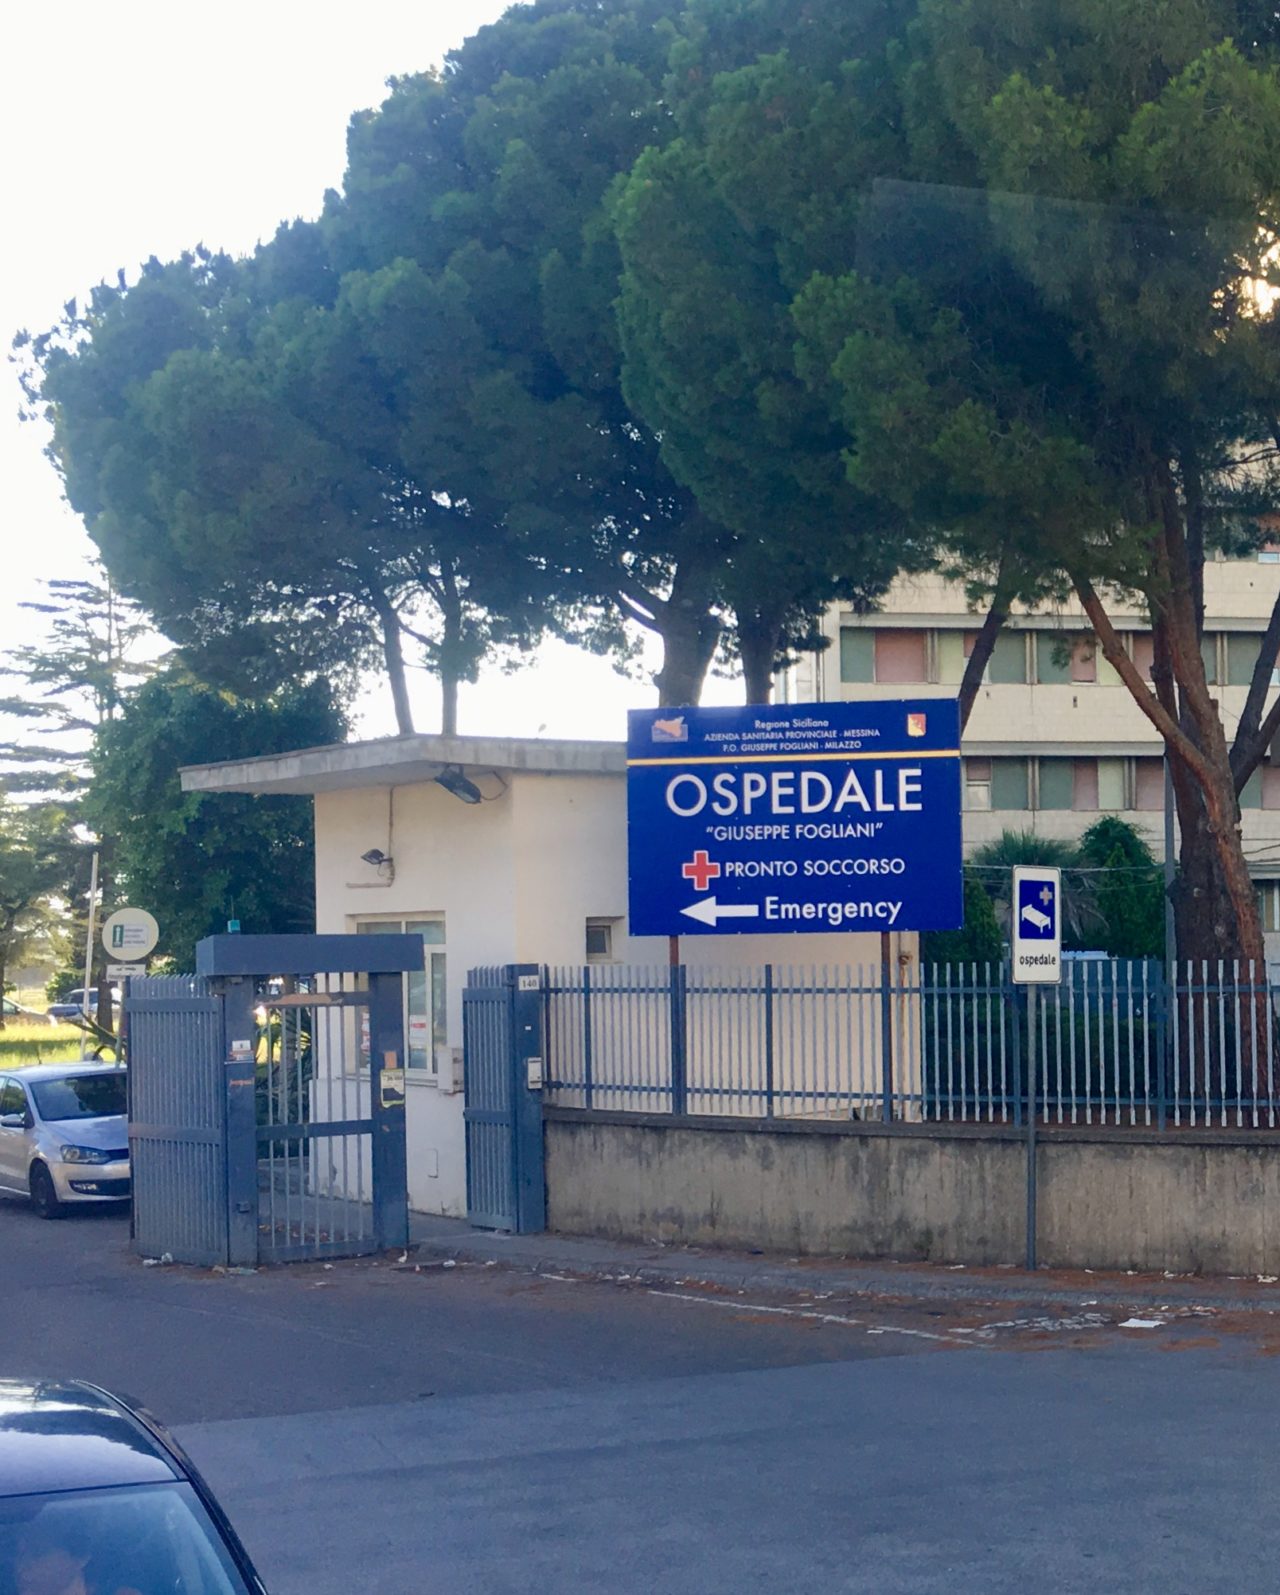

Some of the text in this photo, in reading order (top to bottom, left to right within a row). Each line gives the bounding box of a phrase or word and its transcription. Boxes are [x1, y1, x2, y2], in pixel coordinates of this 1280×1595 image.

[754, 718, 829, 730] Regione Siciliana
[704, 733, 740, 742] AZIENDA
[742, 732, 784, 741] SANITARIA
[785, 730, 837, 740] PROVINCIALE
[844, 729, 880, 738] MESSINA
[741, 742, 778, 752] GIUSEPPE
[780, 742, 818, 750] FOGLIANI
[824, 740, 862, 750] MILAZZO
[666, 768, 922, 817] OSPEDALE
[725, 858, 906, 878] PRONTO SOCCORSO
[765, 896, 902, 925] Emergency
[1020, 954, 1056, 967] ospedale
[522, 979, 537, 988] 140
